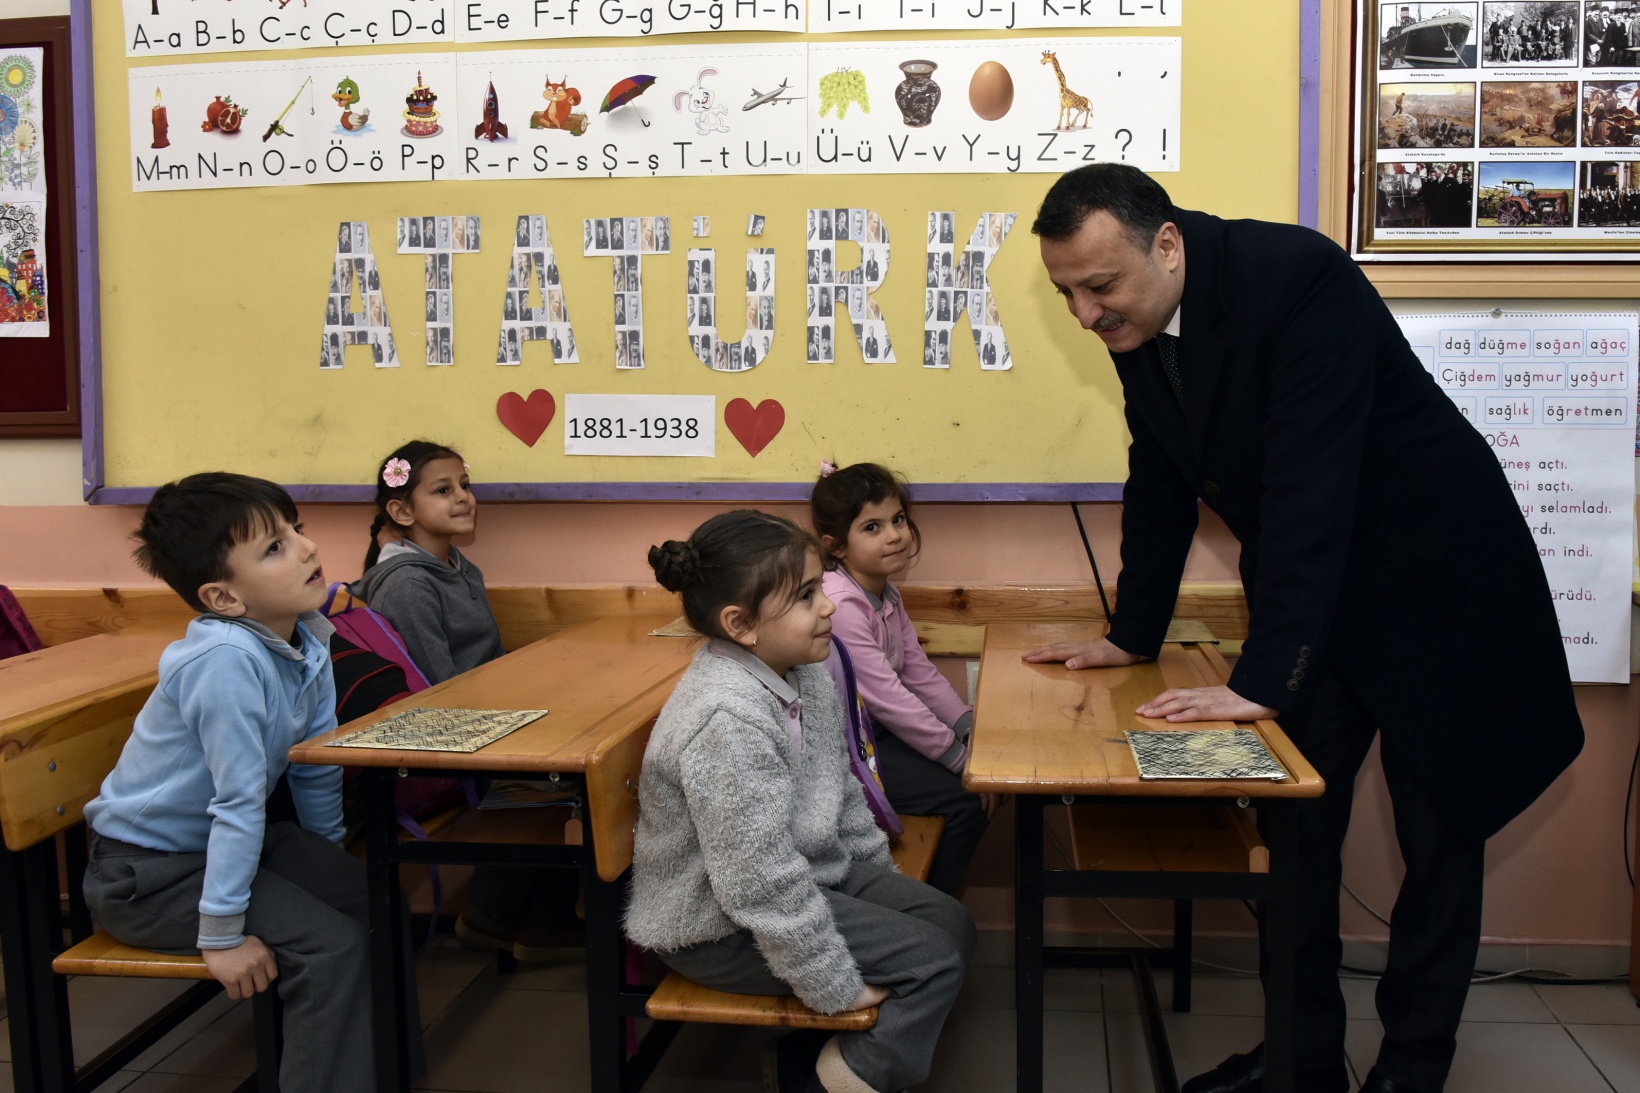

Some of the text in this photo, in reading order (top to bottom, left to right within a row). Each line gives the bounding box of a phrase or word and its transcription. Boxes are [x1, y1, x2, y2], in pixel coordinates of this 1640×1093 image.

[319, 208, 1019, 373] ATATÜRK
[1445, 336, 1626, 355] dağ düğme soğan ağaç
[1442, 368, 1625, 388] Çiğdem yağmur yoğurt
[1488, 402, 1529, 421] sağlık
[1546, 405, 1623, 422] öğretmen
[569, 417, 699, 439] 1881-1938
[1485, 431, 1520, 447] OĞA
[1500, 458, 1568, 471] üneş açtı.
[1537, 480, 1574, 493] saçtı.
[1540, 500, 1612, 514] selamladı.
[1530, 521, 1556, 535] rdı.
[1563, 544, 1593, 557] indi.
[1551, 587, 1596, 601] ürüdü.
[1561, 631, 1598, 645] madı.
